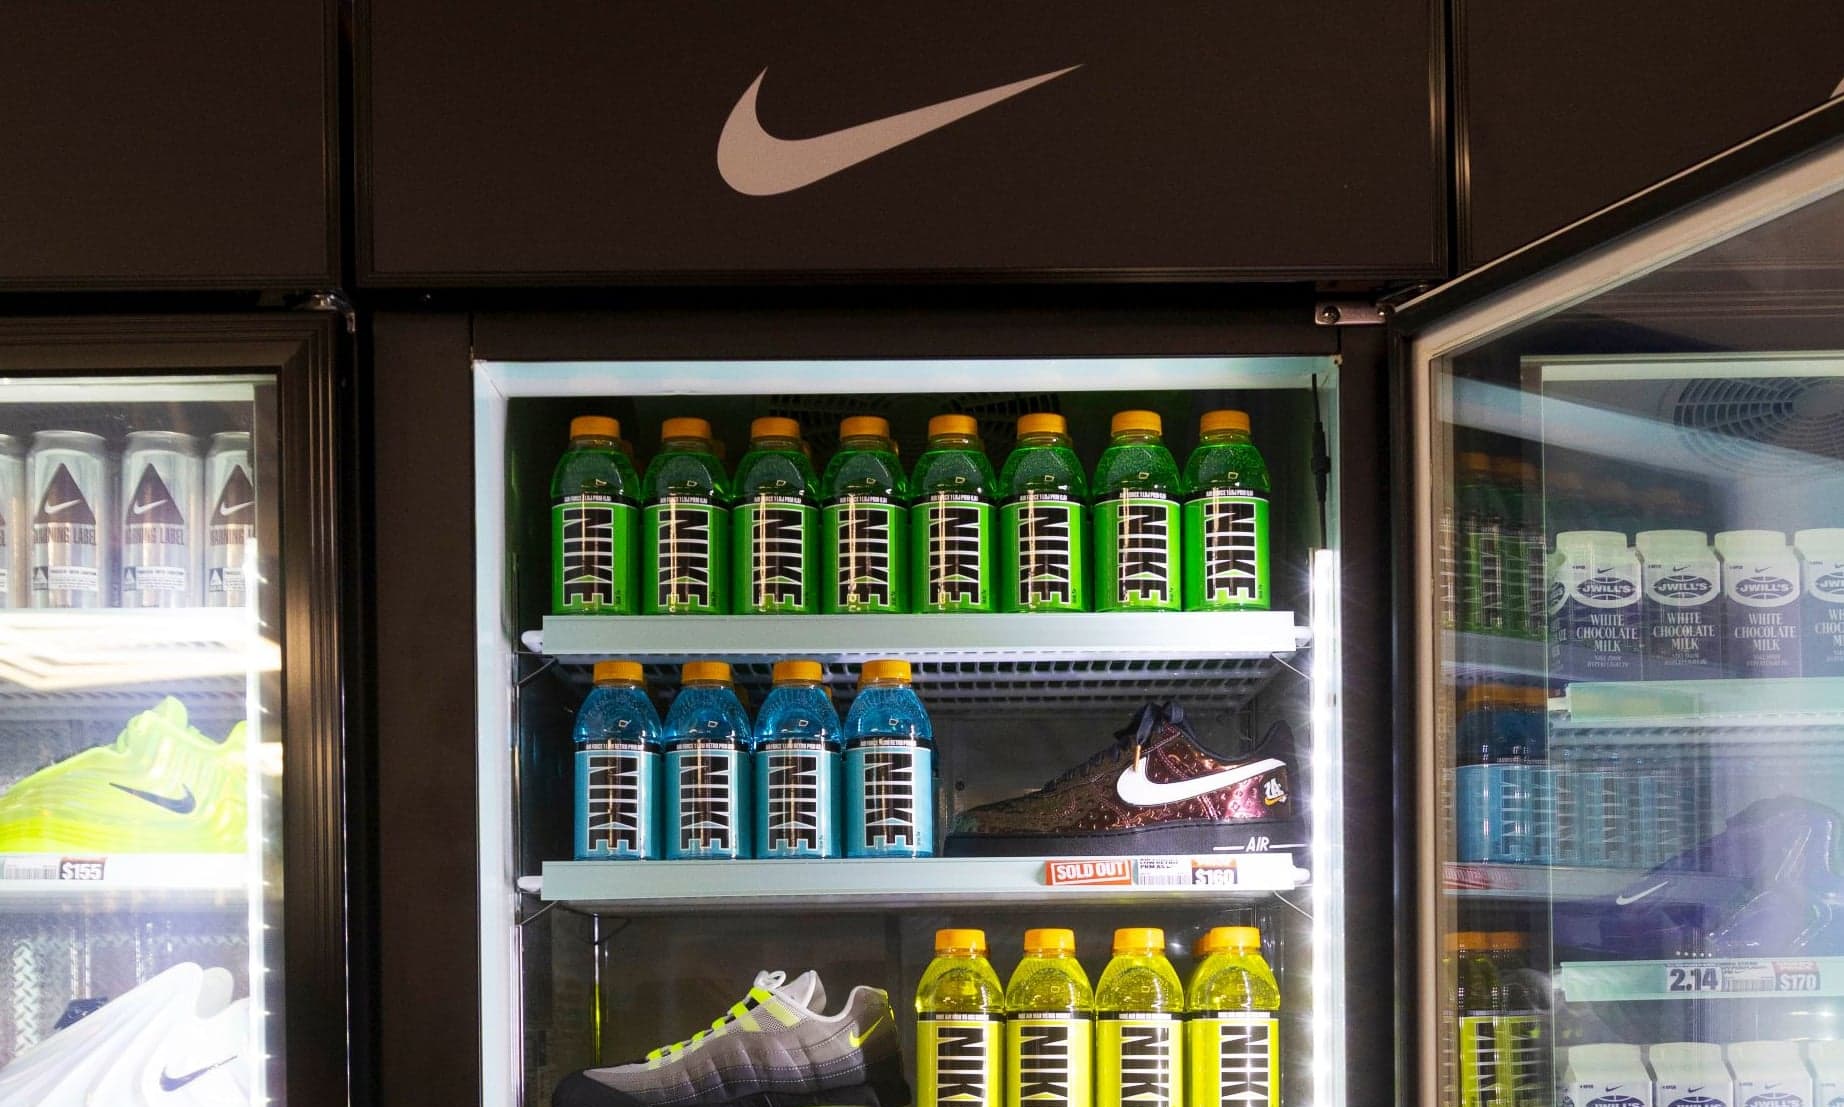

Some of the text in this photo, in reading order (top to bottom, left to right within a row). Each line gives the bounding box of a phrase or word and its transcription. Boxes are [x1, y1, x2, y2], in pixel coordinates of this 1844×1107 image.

[73, 526, 96, 545] LABEL
[160, 527, 184, 546] LABEL
[563, 507, 614, 606] NIKE
[657, 509, 710, 607] NIKE
[752, 508, 804, 607] NIKE
[838, 508, 890, 606] NIKE
[929, 507, 980, 606] NIKE
[1018, 506, 1069, 605] NIKE
[1117, 505, 1168, 603] NIKE
[1205, 503, 1256, 601] NIKE
[1582, 584, 1631, 594] JWILL'S
[1658, 582, 1708, 592] JWILL'S
[1740, 583, 1789, 592] JWILL'S
[1590, 614, 1624, 626] WHITE
[1667, 612, 1702, 625] WHITE
[1748, 612, 1783, 625] WHITE
[1576, 627, 1638, 640] CHOCOLATE
[1653, 624, 1716, 637] CHOCOLATE
[1734, 626, 1796, 638] CHOCOLATE
[1594, 640, 1621, 652] MILK
[1671, 638, 1700, 651] MILK
[1753, 639, 1780, 651] MILK
[588, 755, 639, 850] NIKE
[680, 755, 730, 850] NIKE
[767, 755, 817, 850] NIKE
[864, 752, 914, 847] NIKE
[1246, 836, 1269, 852] AIR
[62, 861, 102, 880] $155
[1056, 864, 1095, 880] SOLD
[1096, 862, 1125, 878] OUT
[1195, 868, 1234, 885] $160
[1670, 968, 1718, 991] 2.14
[1780, 974, 1816, 991] $170
